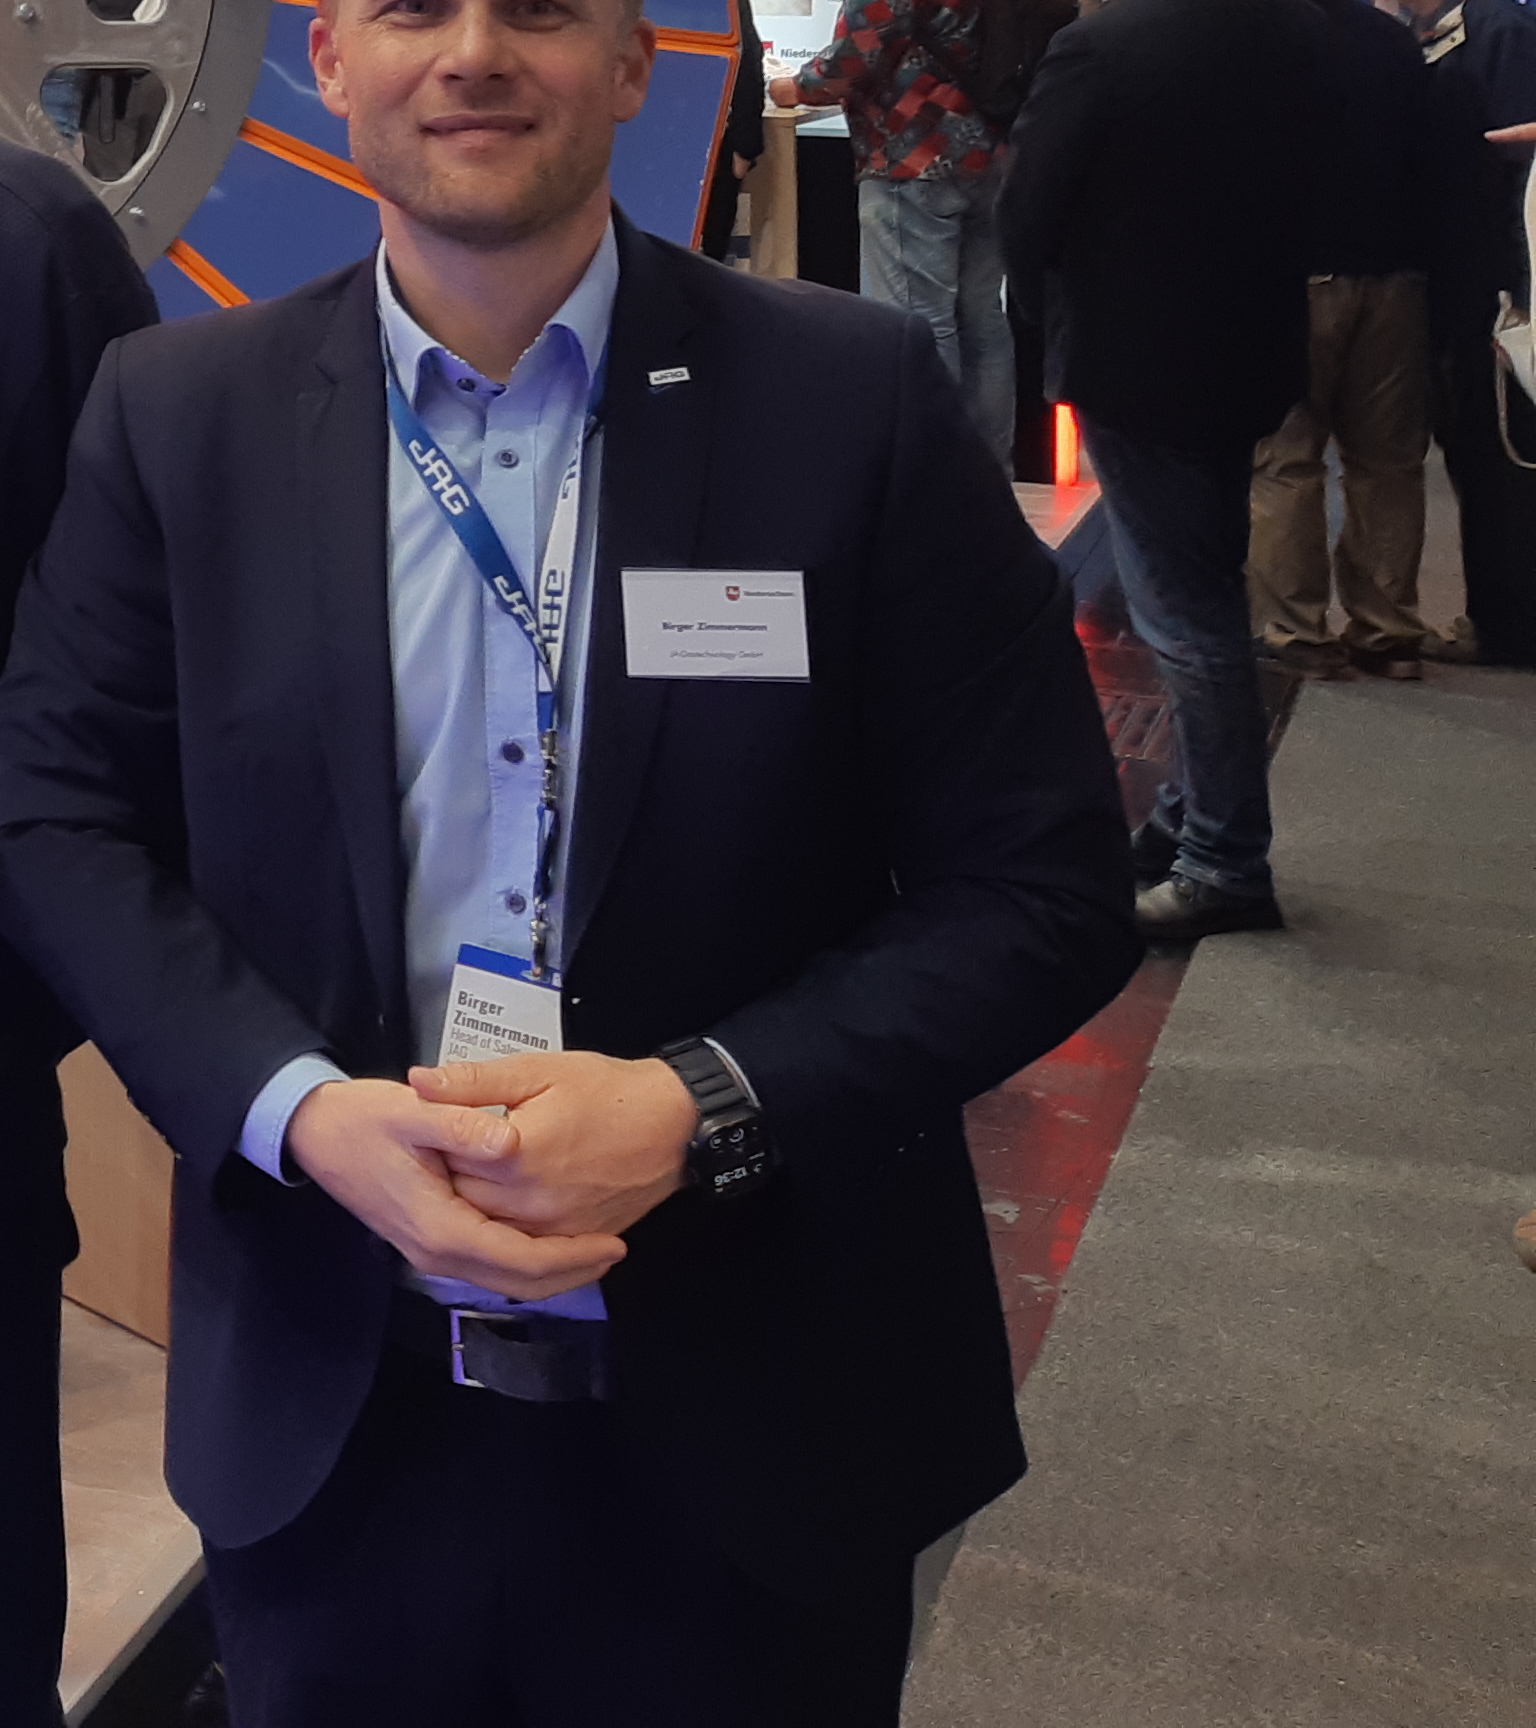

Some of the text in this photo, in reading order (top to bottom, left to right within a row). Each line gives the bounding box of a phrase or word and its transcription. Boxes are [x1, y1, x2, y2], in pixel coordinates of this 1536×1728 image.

[408, 438, 471, 517] JAG
[457, 990, 505, 1016] Birger
[451, 1027, 479, 1046] Head
[453, 1009, 550, 1051] Zimmermann
